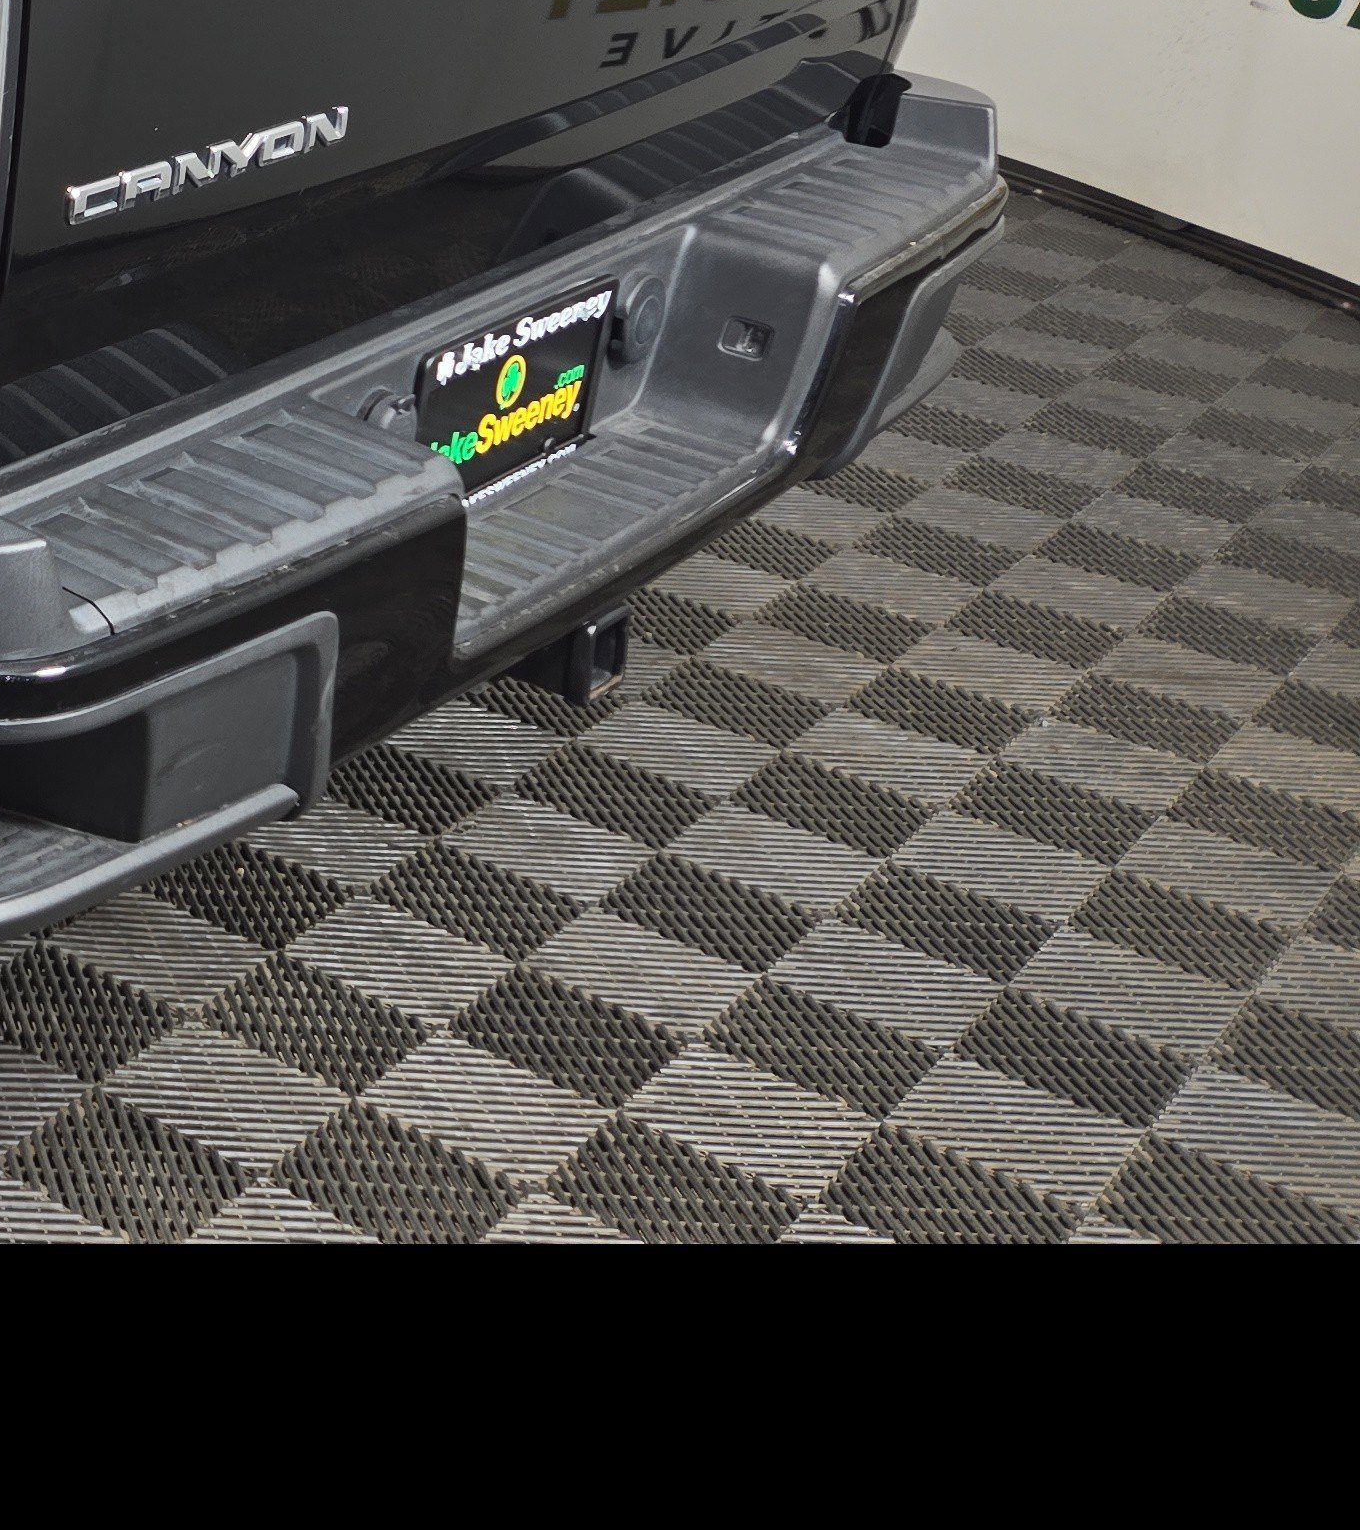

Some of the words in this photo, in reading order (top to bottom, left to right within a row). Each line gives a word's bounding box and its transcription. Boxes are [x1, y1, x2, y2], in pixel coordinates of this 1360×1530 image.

[65, 105, 349, 225] CANYON
[454, 333, 511, 373] Jake
[512, 290, 612, 348] Sweeney
